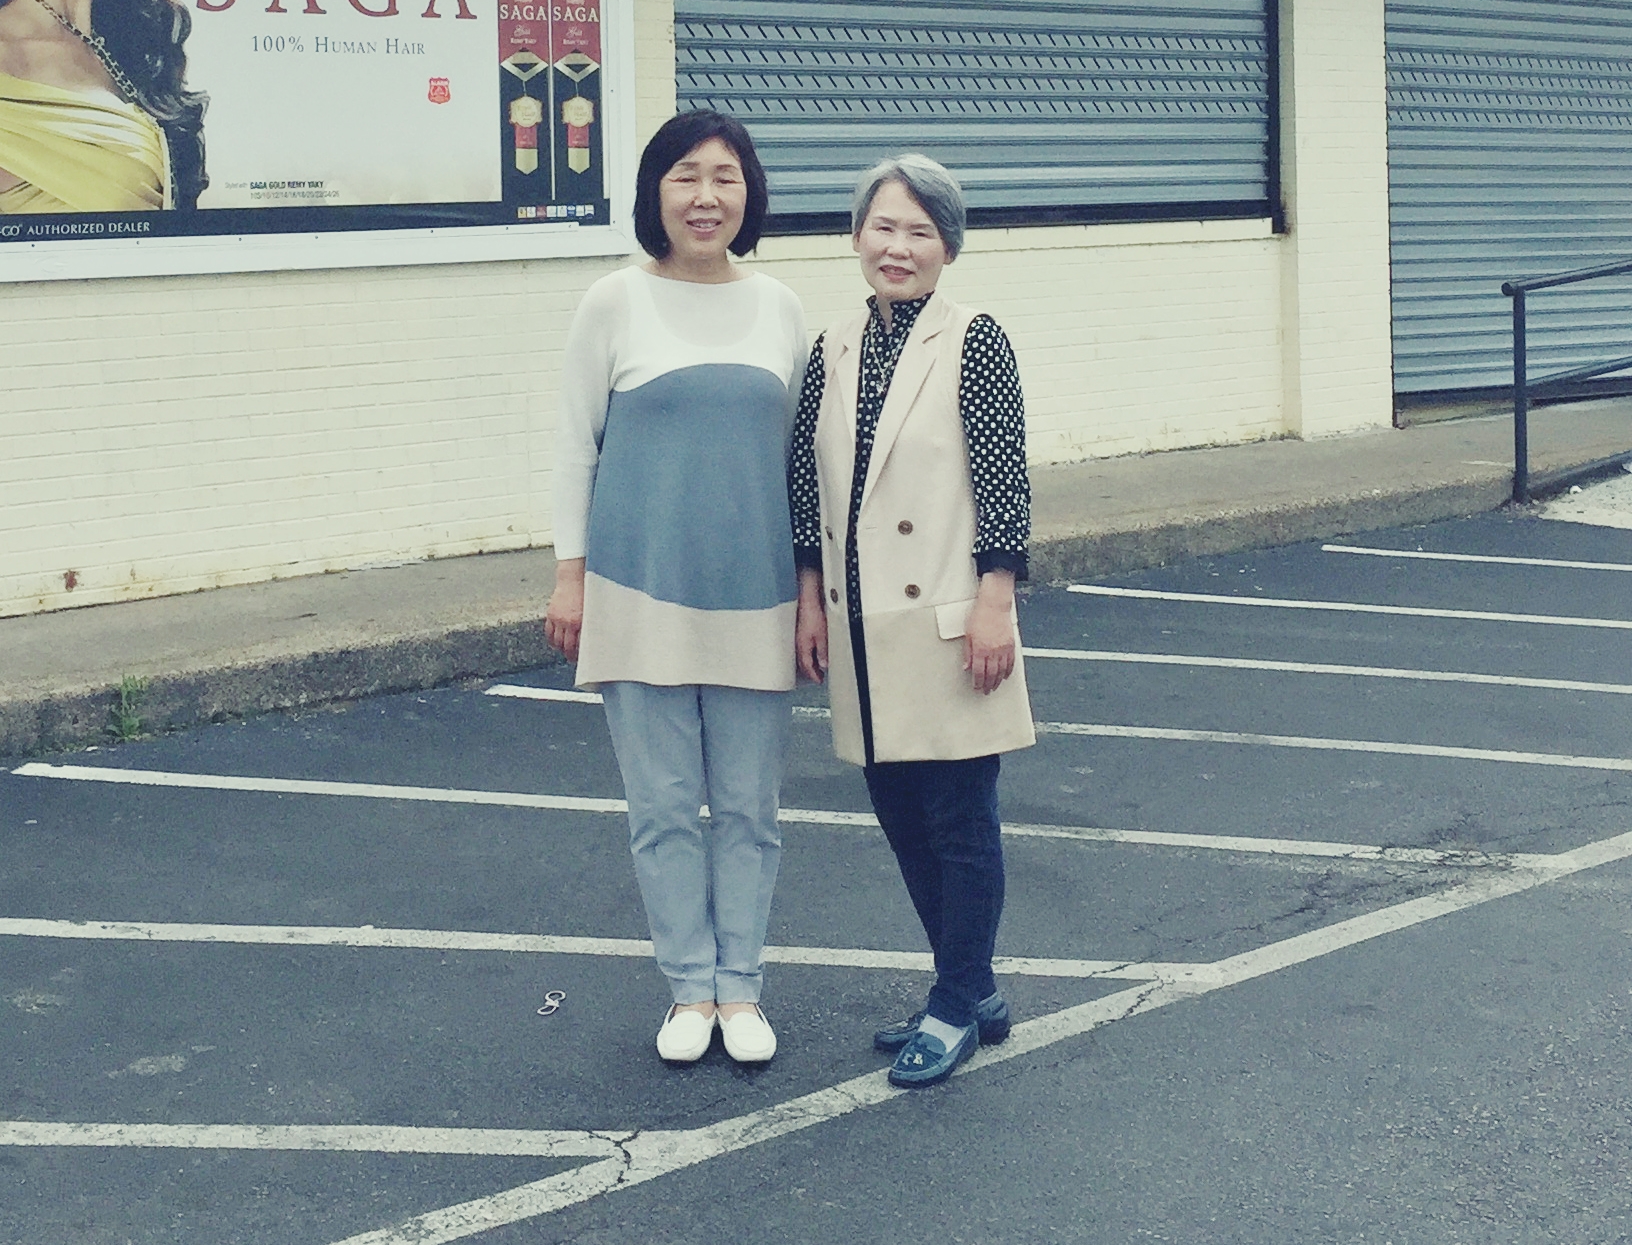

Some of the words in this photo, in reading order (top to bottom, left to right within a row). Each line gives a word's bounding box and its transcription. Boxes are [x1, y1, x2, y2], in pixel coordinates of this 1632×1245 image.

[500, 4, 547, 21] SAGA
[553, 6, 599, 22] SAGA
[251, 35, 305, 53] 100%
[315, 36, 377, 54] HUMAN
[386, 38, 426, 55] HAIR
[27, 223, 105, 235] AUTHORIZED
[108, 221, 150, 232] DEALER
